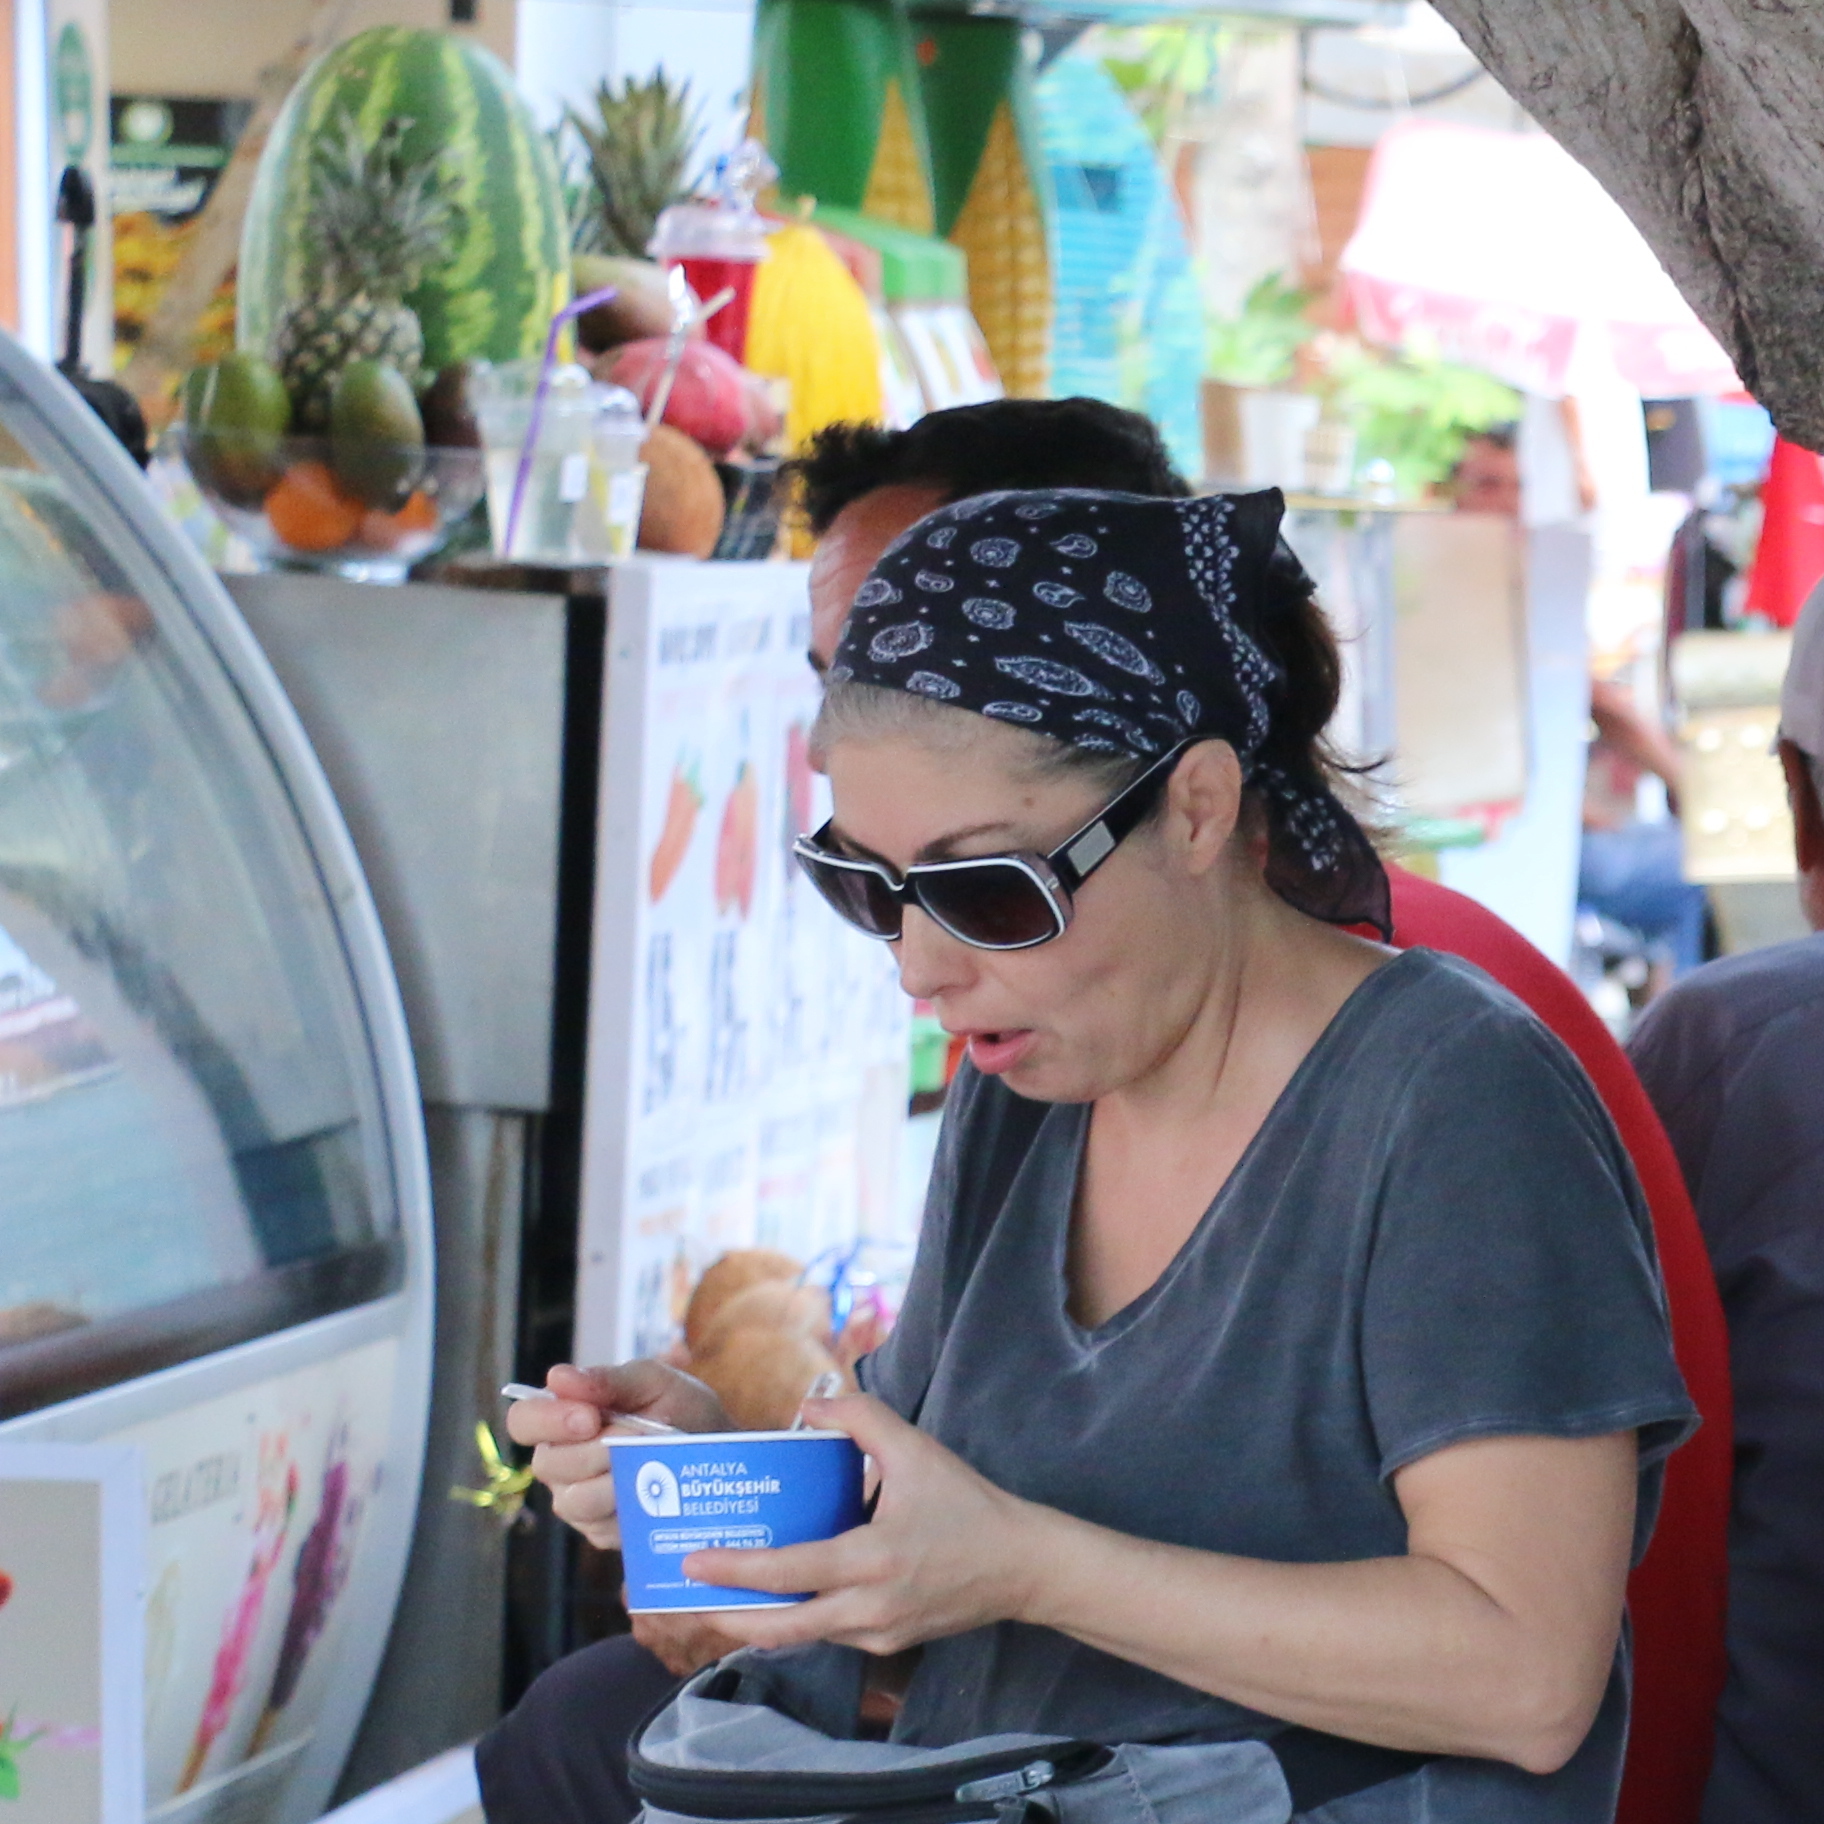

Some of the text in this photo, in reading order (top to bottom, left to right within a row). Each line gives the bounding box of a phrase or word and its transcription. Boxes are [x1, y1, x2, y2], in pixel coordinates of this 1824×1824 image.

[680, 1462, 748, 1478] ANTALYA
[681, 1475, 781, 1498] BÜYÜKŞEHİR
[682, 1498, 759, 1517] BELEDİYESİ
